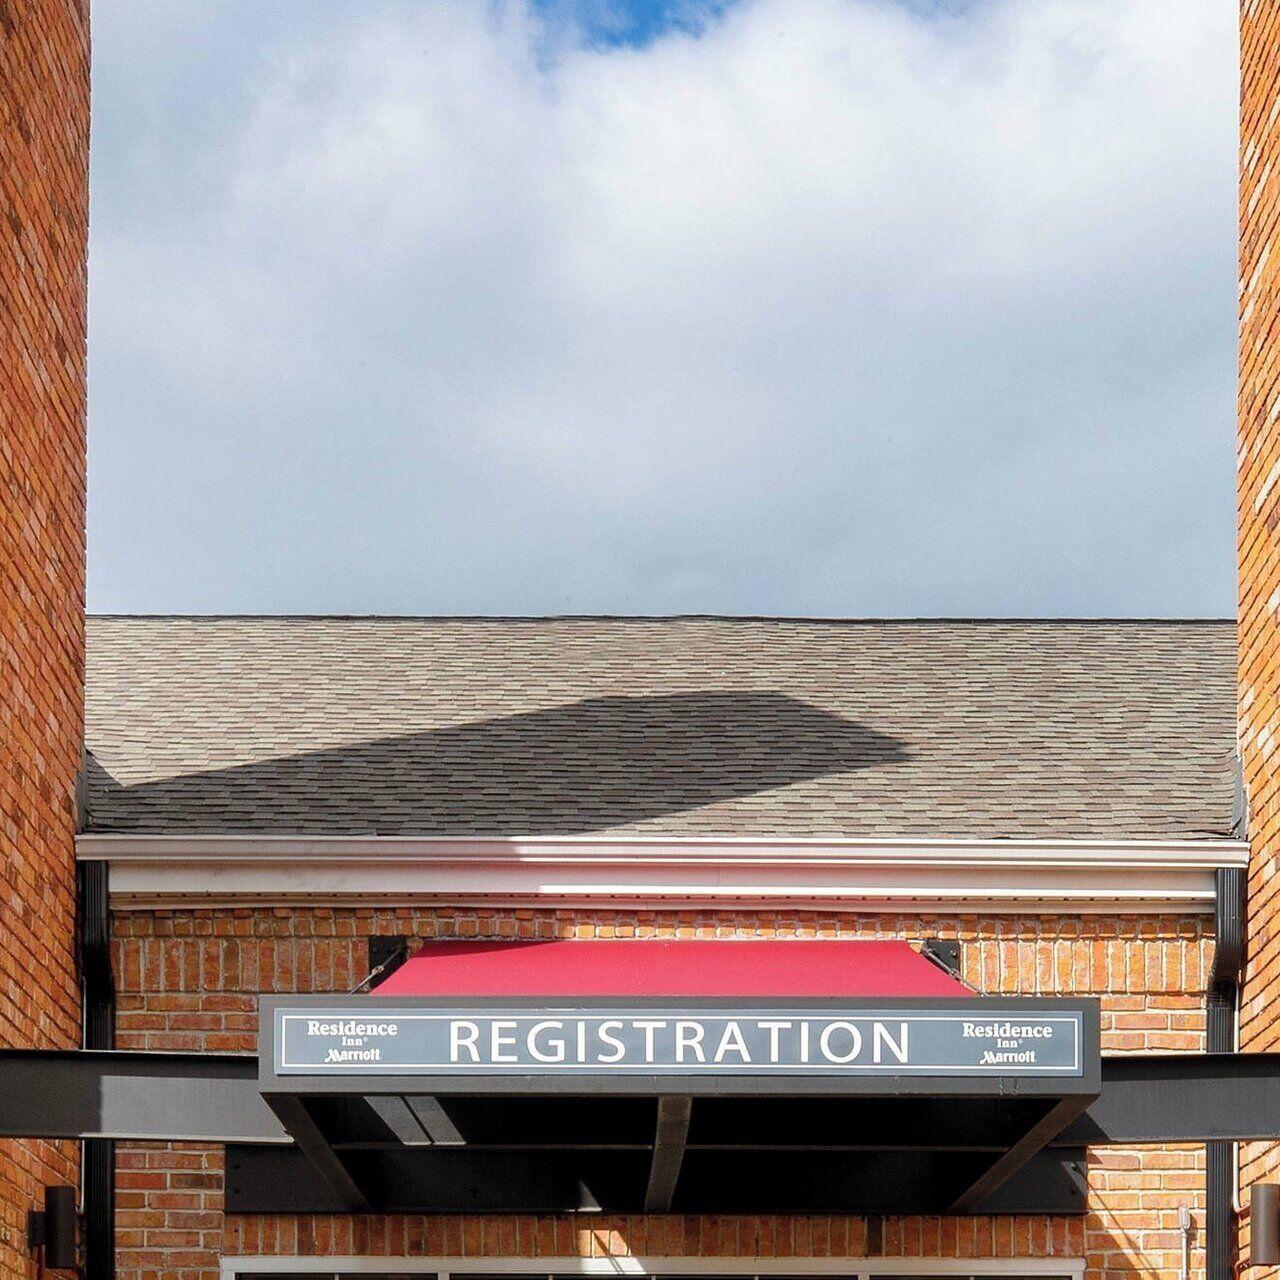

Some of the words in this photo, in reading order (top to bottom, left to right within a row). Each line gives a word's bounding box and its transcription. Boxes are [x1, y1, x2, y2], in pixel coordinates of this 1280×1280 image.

[307, 1020, 398, 1036] Residence
[962, 1022, 1053, 1038] Residence
[449, 1021, 909, 1064] REGISTRATION
[324, 1048, 382, 1063] Marriott
[979, 1050, 1036, 1065] Marriott
